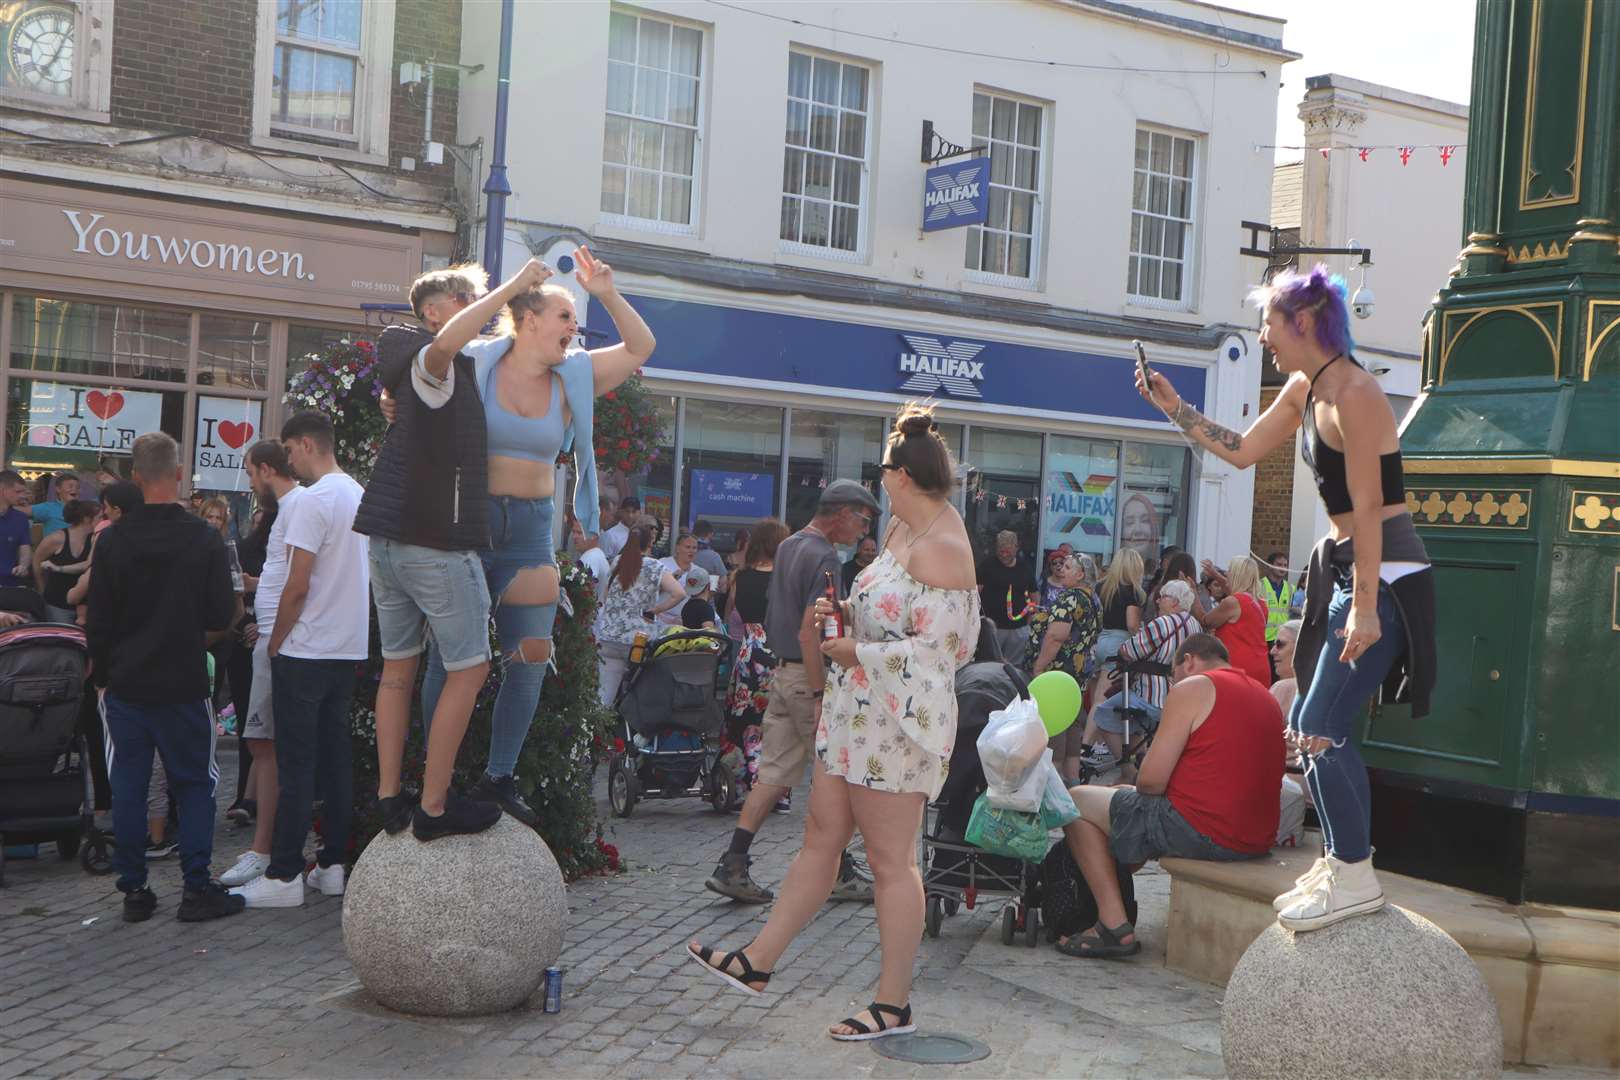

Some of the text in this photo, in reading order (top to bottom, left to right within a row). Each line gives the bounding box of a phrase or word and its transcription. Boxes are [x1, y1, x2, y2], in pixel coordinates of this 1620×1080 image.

[925, 182, 980, 208] HALIFAX
[62, 209, 315, 281] Youwomen.
[900, 352, 984, 380] HALIFAX
[67, 387, 86, 419] I
[200, 417, 218, 449] I
[709, 493, 756, 503] cash machine
